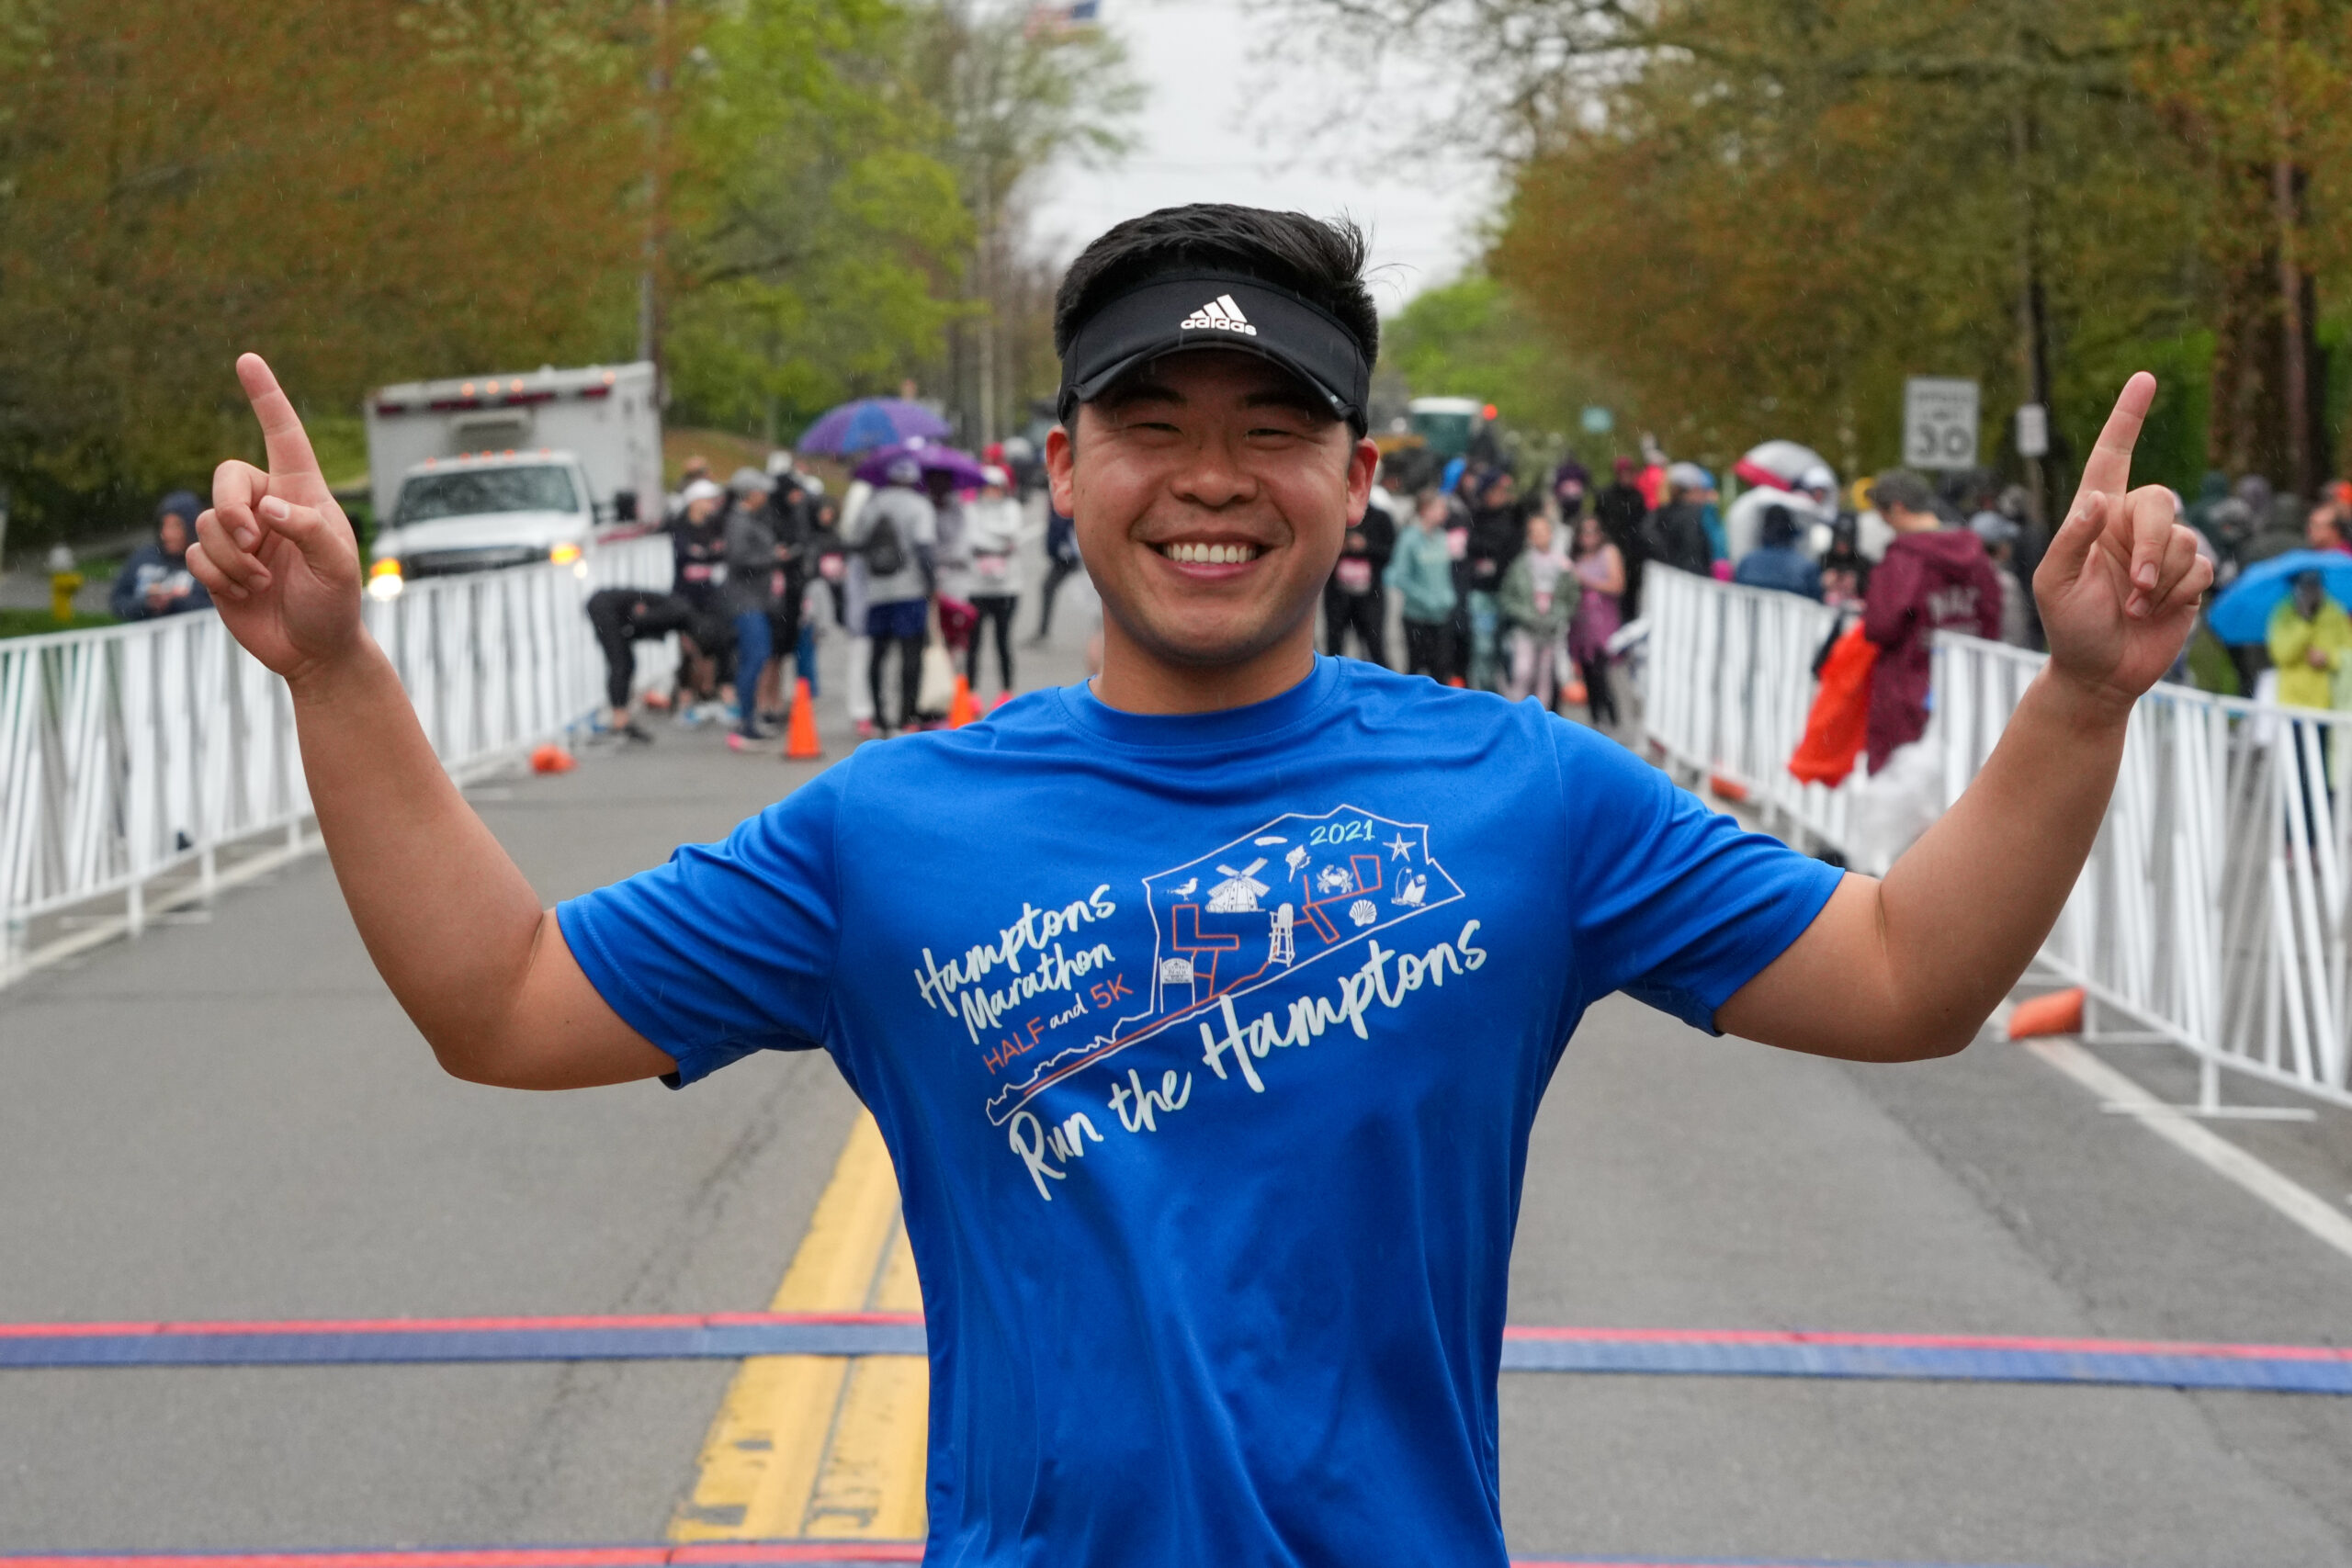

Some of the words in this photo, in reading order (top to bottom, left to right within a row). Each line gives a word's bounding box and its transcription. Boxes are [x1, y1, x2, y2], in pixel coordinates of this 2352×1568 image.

[1181, 316, 1257, 336] adidas
[1917, 423, 1972, 458] 30
[1310, 819, 1376, 847] 2021
[914, 884, 1116, 1018] Hamptons
[961, 942, 1116, 1045] Marathon
[983, 1016, 1045, 1076] HALF
[1049, 992, 1089, 1030] and
[1090, 973, 1134, 1010] 5K
[1009, 1111, 1104, 1202] Run
[1108, 1068, 1193, 1133] the
[1198, 919, 1487, 1093] Hamptons
